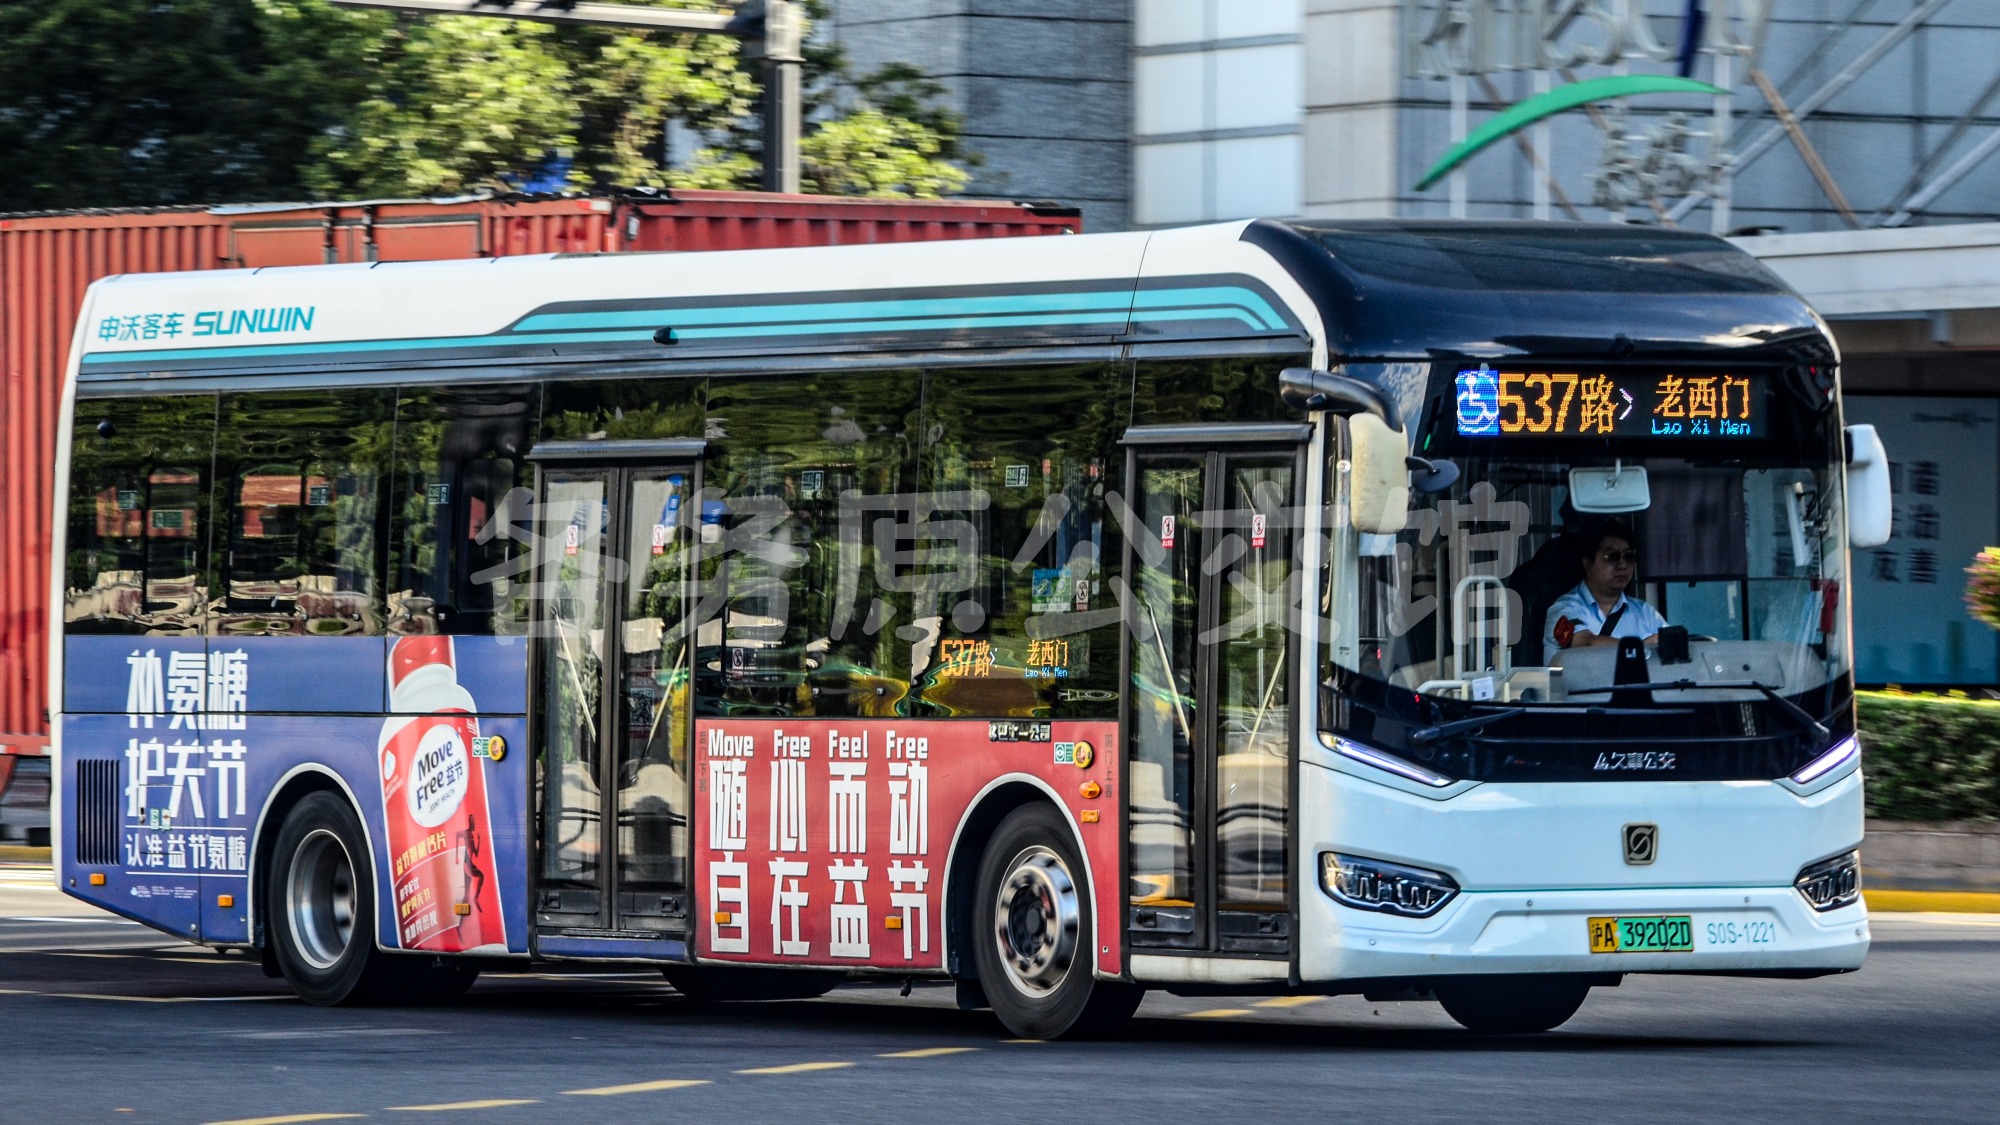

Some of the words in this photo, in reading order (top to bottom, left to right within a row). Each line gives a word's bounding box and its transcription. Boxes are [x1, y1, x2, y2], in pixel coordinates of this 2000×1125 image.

[98, 310, 185, 342] 申沃客车
[192, 306, 315, 337] SUNWIN
[1498, 373, 1618, 434] 537路
[1653, 374, 1750, 419] 老西门
[1651, 419, 1682, 435] Lao
[1690, 419, 1710, 435] Xi
[1719, 419, 1752, 435] Men
[941, 640, 991, 677] 537路
[1026, 640, 1069, 667] 老西门
[1025, 667, 1039, 677] Lao
[1041, 667, 1051, 677] Xi
[1054, 666, 1068, 677] Men
[126, 648, 248, 730] 补氨糖
[418, 741, 453, 781] Move
[708, 728, 754, 757] Move
[773, 729, 811, 758] Free
[828, 730, 868, 758] Feel
[886, 730, 928, 759] Free
[125, 737, 247, 819] 护关节
[416, 771, 444, 810] Free
[446, 759, 464, 786] 益节
[709, 758, 929, 855] 随心而动
[125, 833, 246, 871] 认准益节氨糖
[709, 851, 931, 960] 自在益节
[1624, 921, 1691, 947] 39202D
